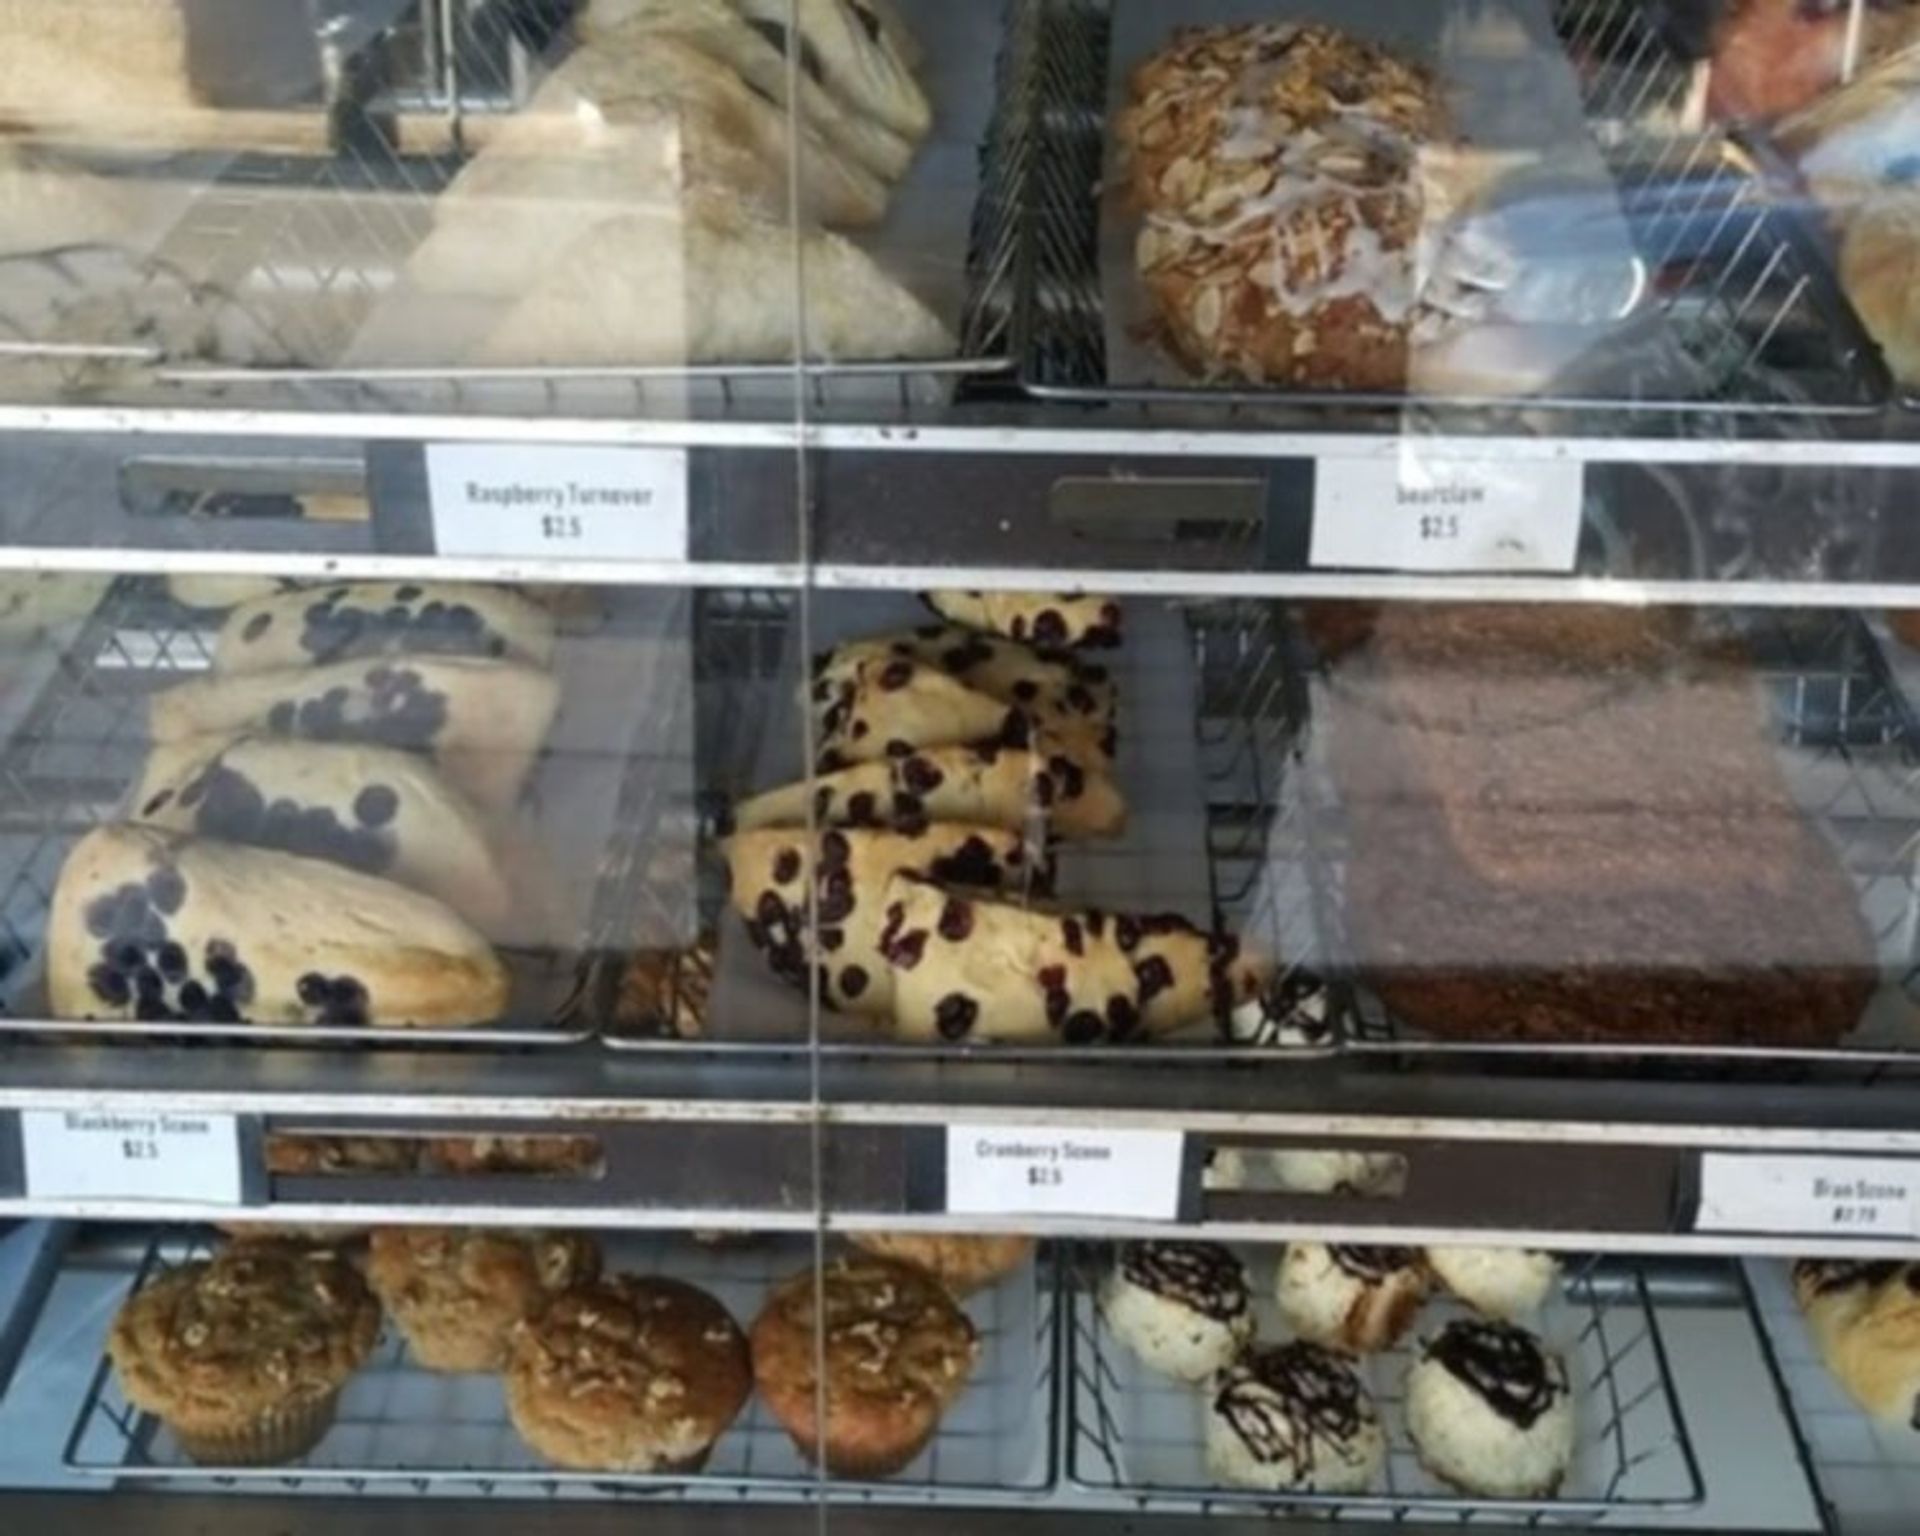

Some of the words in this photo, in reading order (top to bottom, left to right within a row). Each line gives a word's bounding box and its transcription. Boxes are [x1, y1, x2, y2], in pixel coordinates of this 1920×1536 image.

[466, 481, 563, 508] Raspberry
[542, 515, 581, 537] $2.5
[1420, 515, 1459, 539] $2.5
